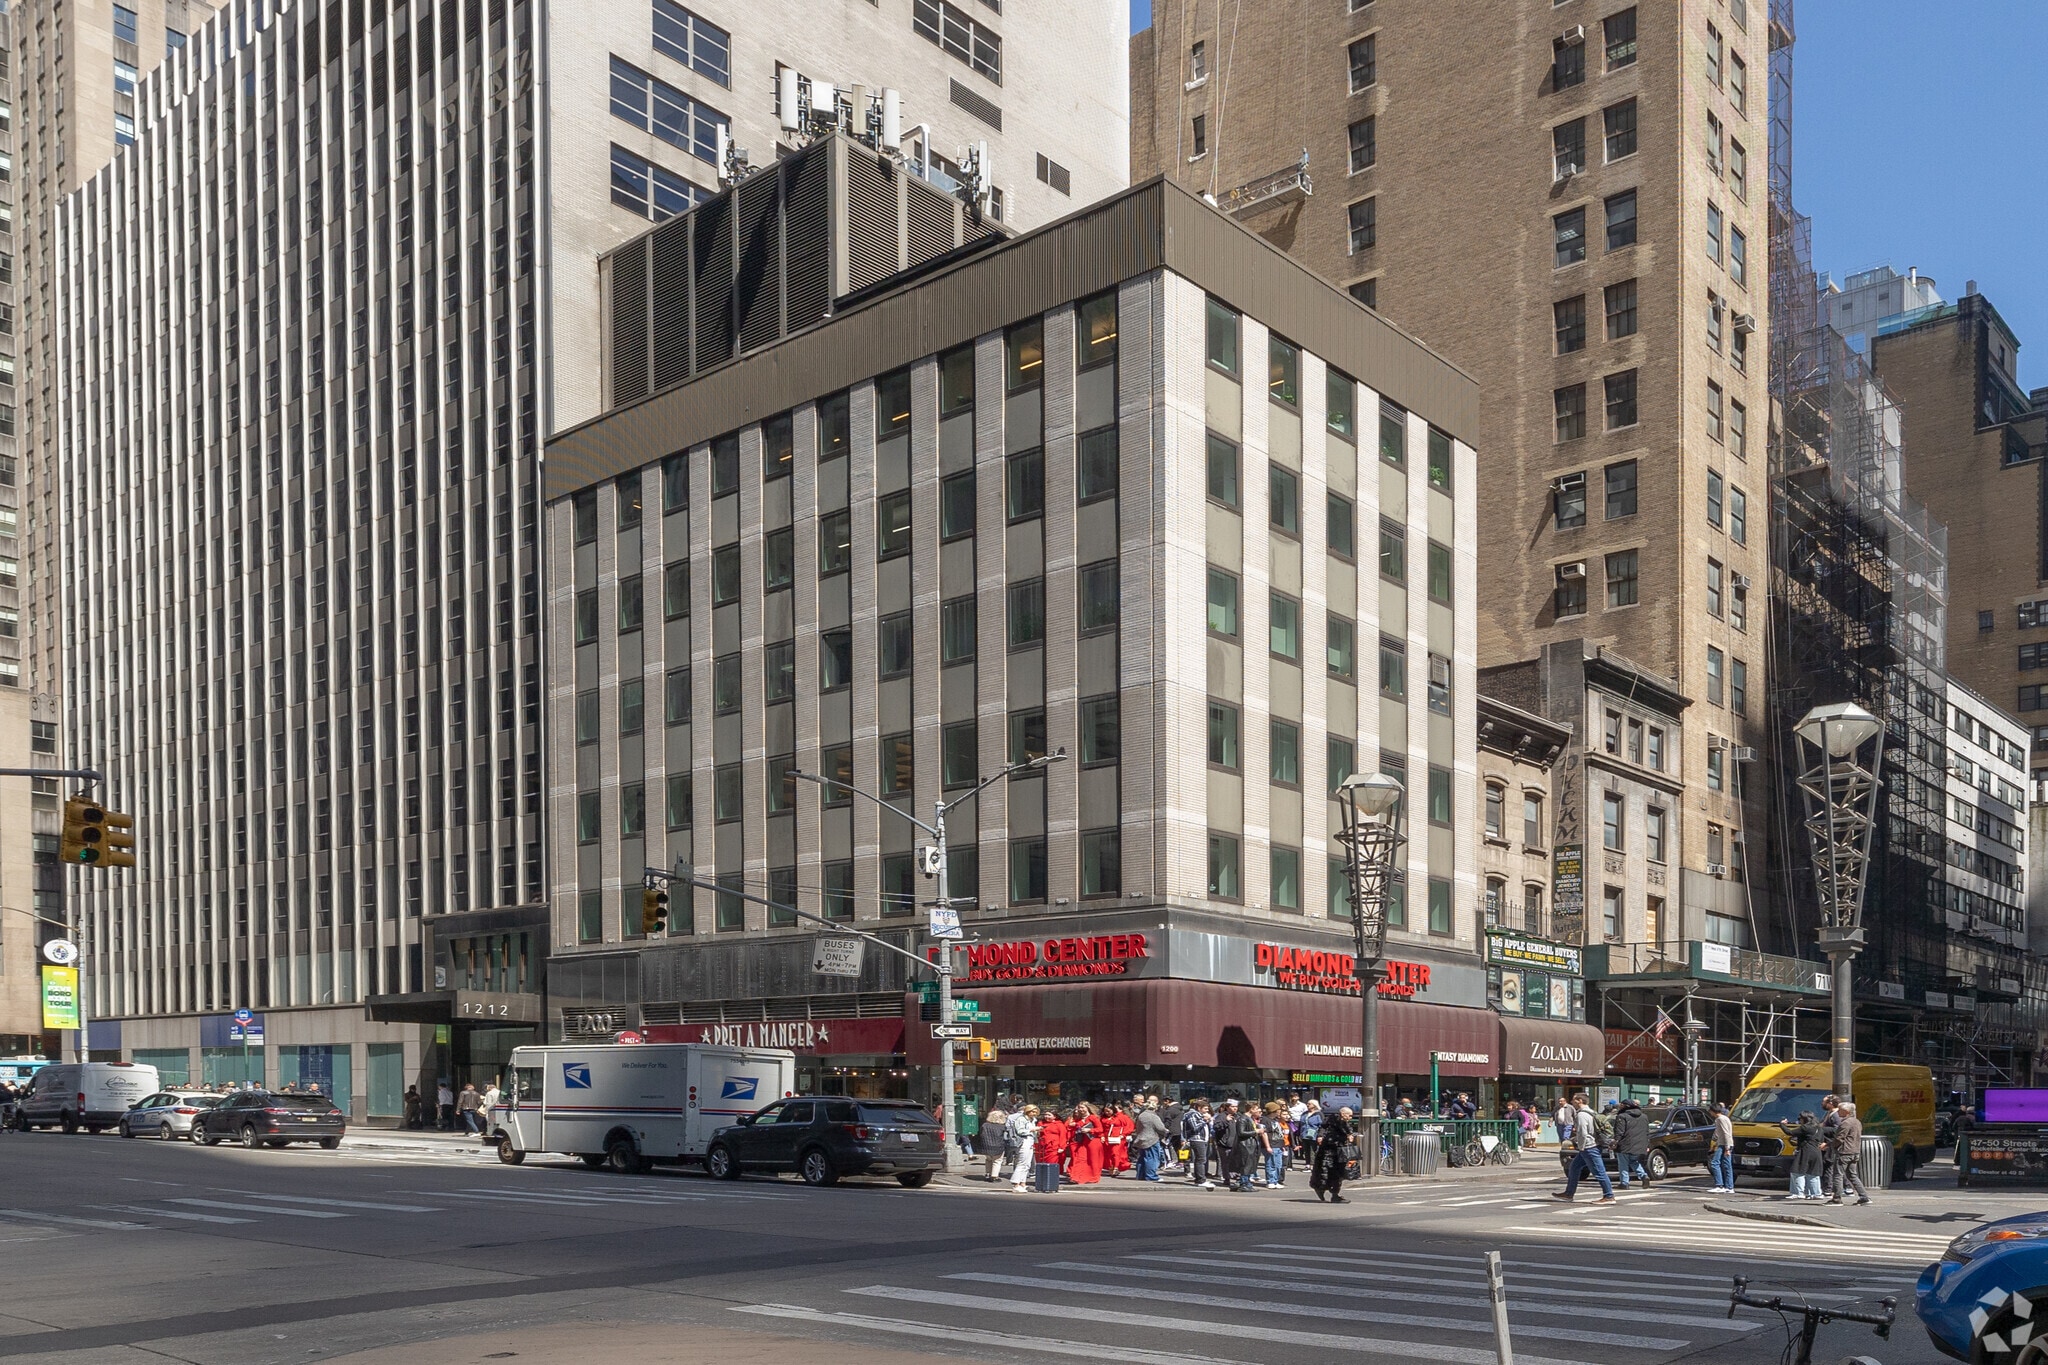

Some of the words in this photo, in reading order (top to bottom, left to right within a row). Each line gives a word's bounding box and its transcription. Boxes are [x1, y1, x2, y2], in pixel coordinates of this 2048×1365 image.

[935, 910, 957, 918] NYPD
[824, 940, 855, 950] BUSES
[926, 941, 1037, 970] DMOND
[1043, 933, 1147, 963] CENTER
[1504, 939, 1526, 951] APPLE
[1526, 942, 1554, 955] GENERAL
[1554, 947, 1578, 959] BUYERS
[825, 953, 850, 962] ONLY
[1256, 943, 1354, 976] DIAMOND
[1386, 960, 1431, 985] NTER
[969, 968, 995, 982] BUY
[996, 966, 1035, 979] GOLD
[1035, 965, 1046, 978] &
[1047, 961, 1126, 978] DIAMONDS
[1279, 971, 1296, 985] WE
[1299, 972, 1321, 987] BUY
[1321, 977, 1353, 990] GOLD
[463, 1002, 509, 1017] 1212
[964, 1001, 971, 1010] 47
[713, 1024, 742, 1047] PRET
[746, 1023, 755, 1047] A
[759, 1021, 815, 1048] MANGER
[1605, 1033, 1626, 1047] TAIL
[1627, 1034, 1646, 1048] FOR
[996, 1037, 1037, 1050] JEWELRY
[1038, 1036, 1091, 1049] EXCHANGE
[1160, 1045, 1179, 1053] 1200
[1304, 1043, 1341, 1057] MALIDANI
[1457, 1052, 1489, 1064] DIAMONDS
[1530, 1041, 1583, 1063] ZOLAND
[630, 1061, 648, 1069] Deliver
[1529, 1065, 1547, 1073] Diamond
[1551, 1066, 1565, 1075] Jewelry
[1565, 1067, 1583, 1075] Exchange
[1292, 1073, 1306, 1082] SELL
[1340, 1075, 1355, 1083] GOLD
[1355, 1075, 1363, 1084] HE
[1900, 1090, 1926, 1104] DHL
[1423, 1124, 1445, 1133] Subway
[1970, 1139, 2000, 1147] 47-50
[2002, 1139, 2038, 1148] Streets
